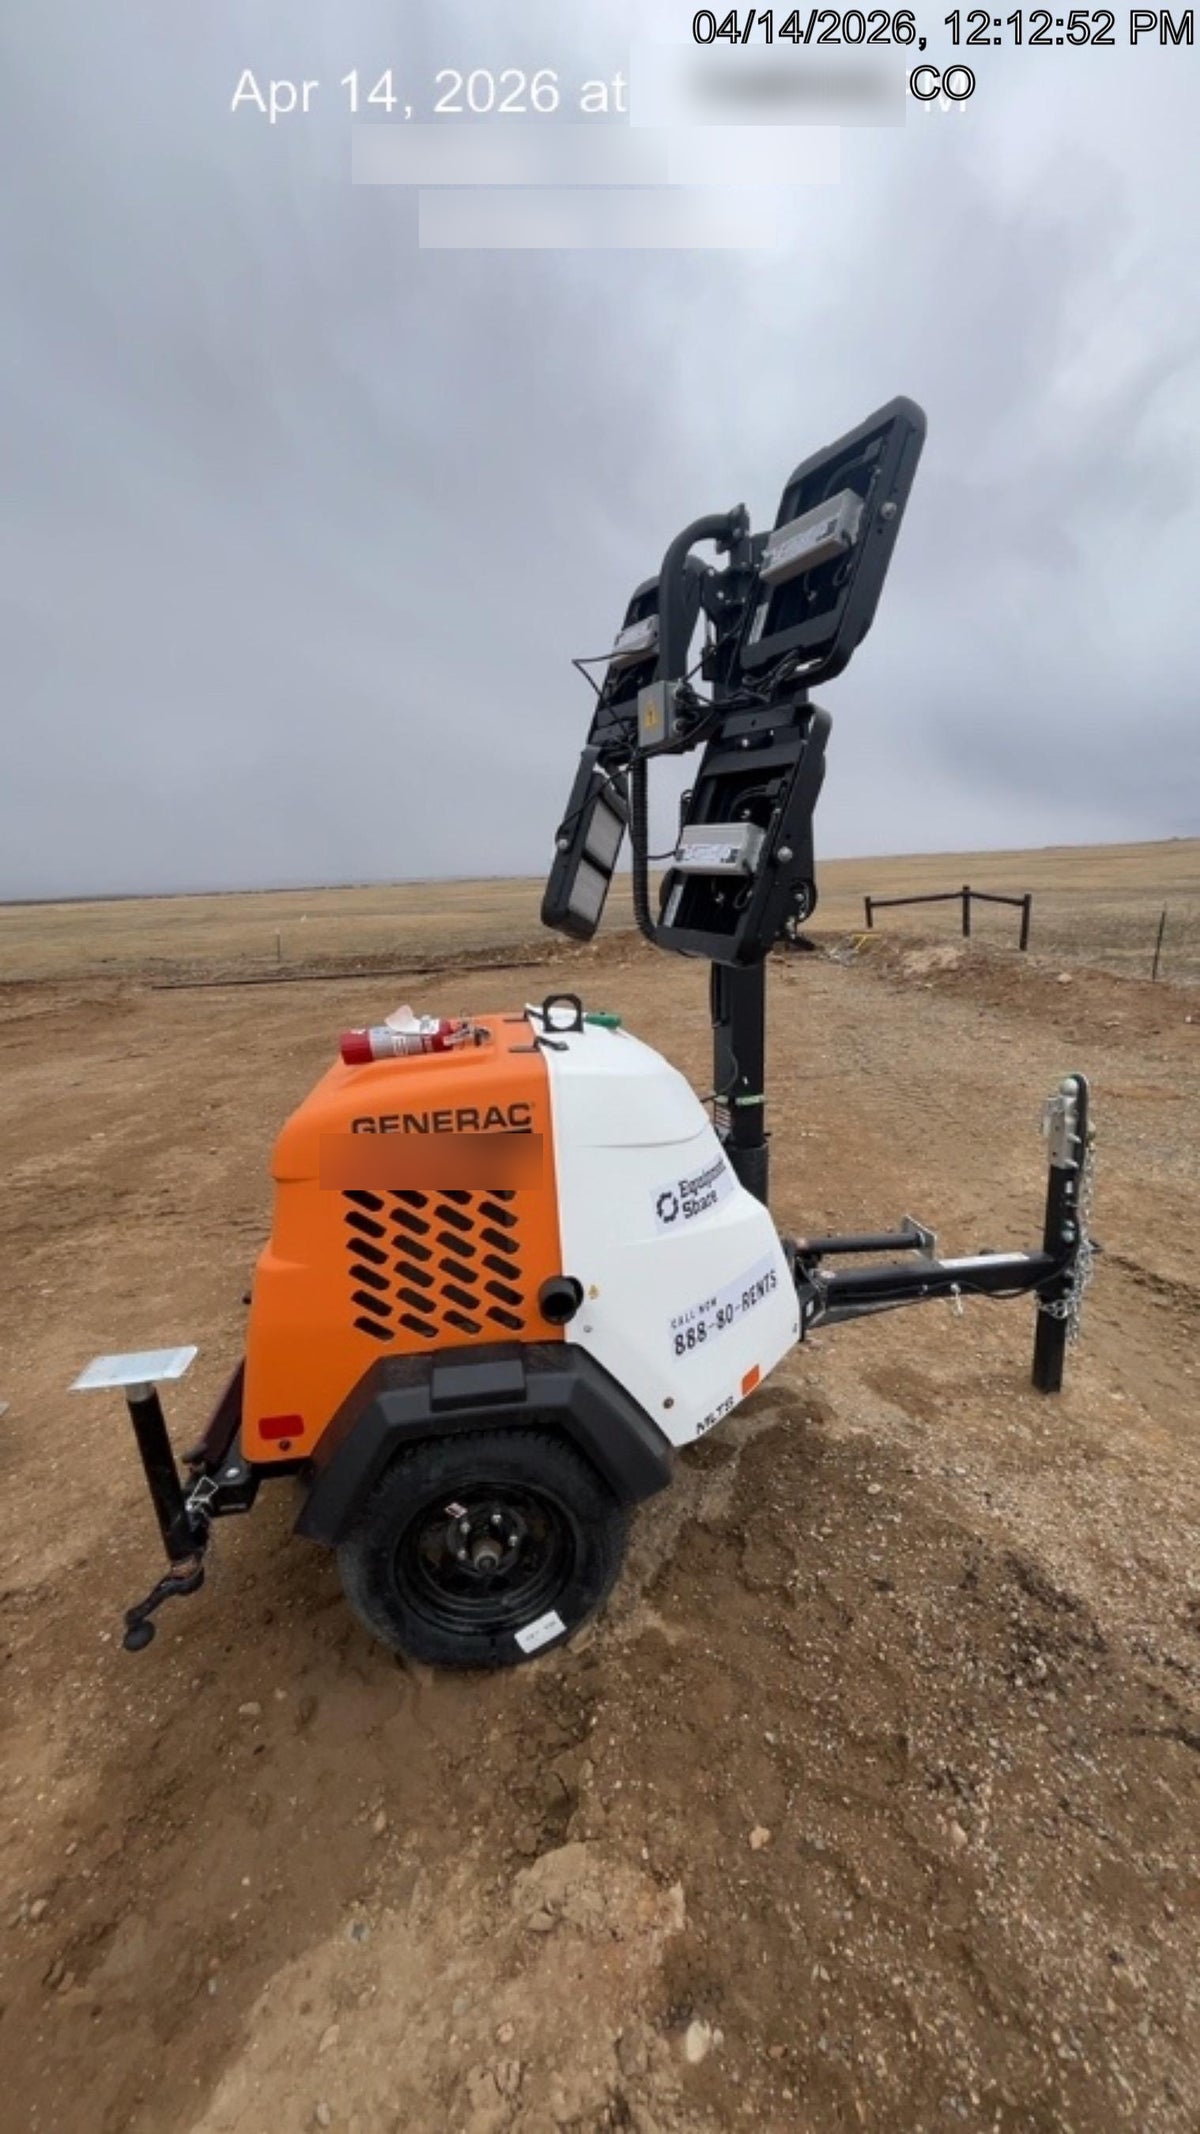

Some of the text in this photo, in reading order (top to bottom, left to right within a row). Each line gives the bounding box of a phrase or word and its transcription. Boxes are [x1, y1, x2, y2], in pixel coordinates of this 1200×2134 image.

[352, 1102, 533, 1134] GENERAC
[683, 1190, 718, 1219] Share
[674, 1268, 776, 1356] 888-80-RENTS
